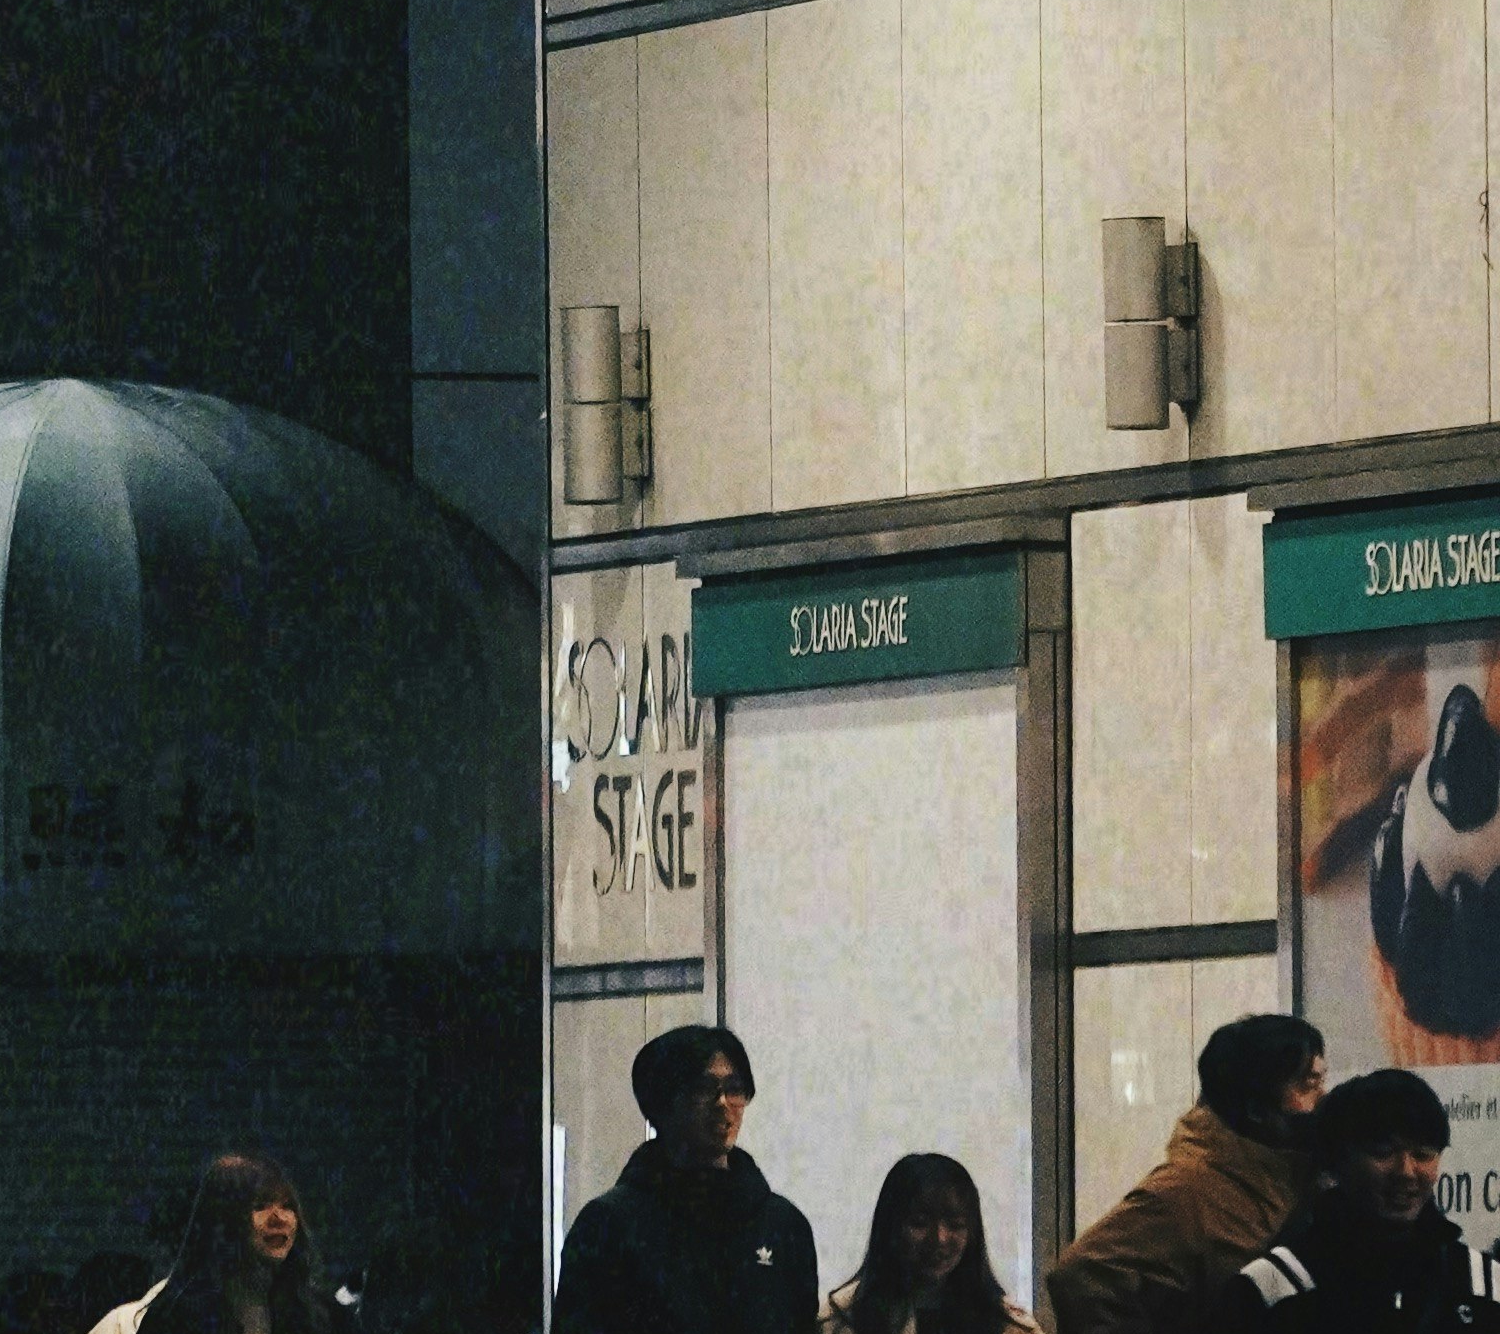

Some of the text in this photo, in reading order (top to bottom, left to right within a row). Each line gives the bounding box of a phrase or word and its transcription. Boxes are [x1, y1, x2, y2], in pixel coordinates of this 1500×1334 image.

[1365, 529, 1500, 597] SOLARIA STAGE
[789, 594, 909, 657] SOLARIA STAGE
[592, 768, 698, 897] STAGE
